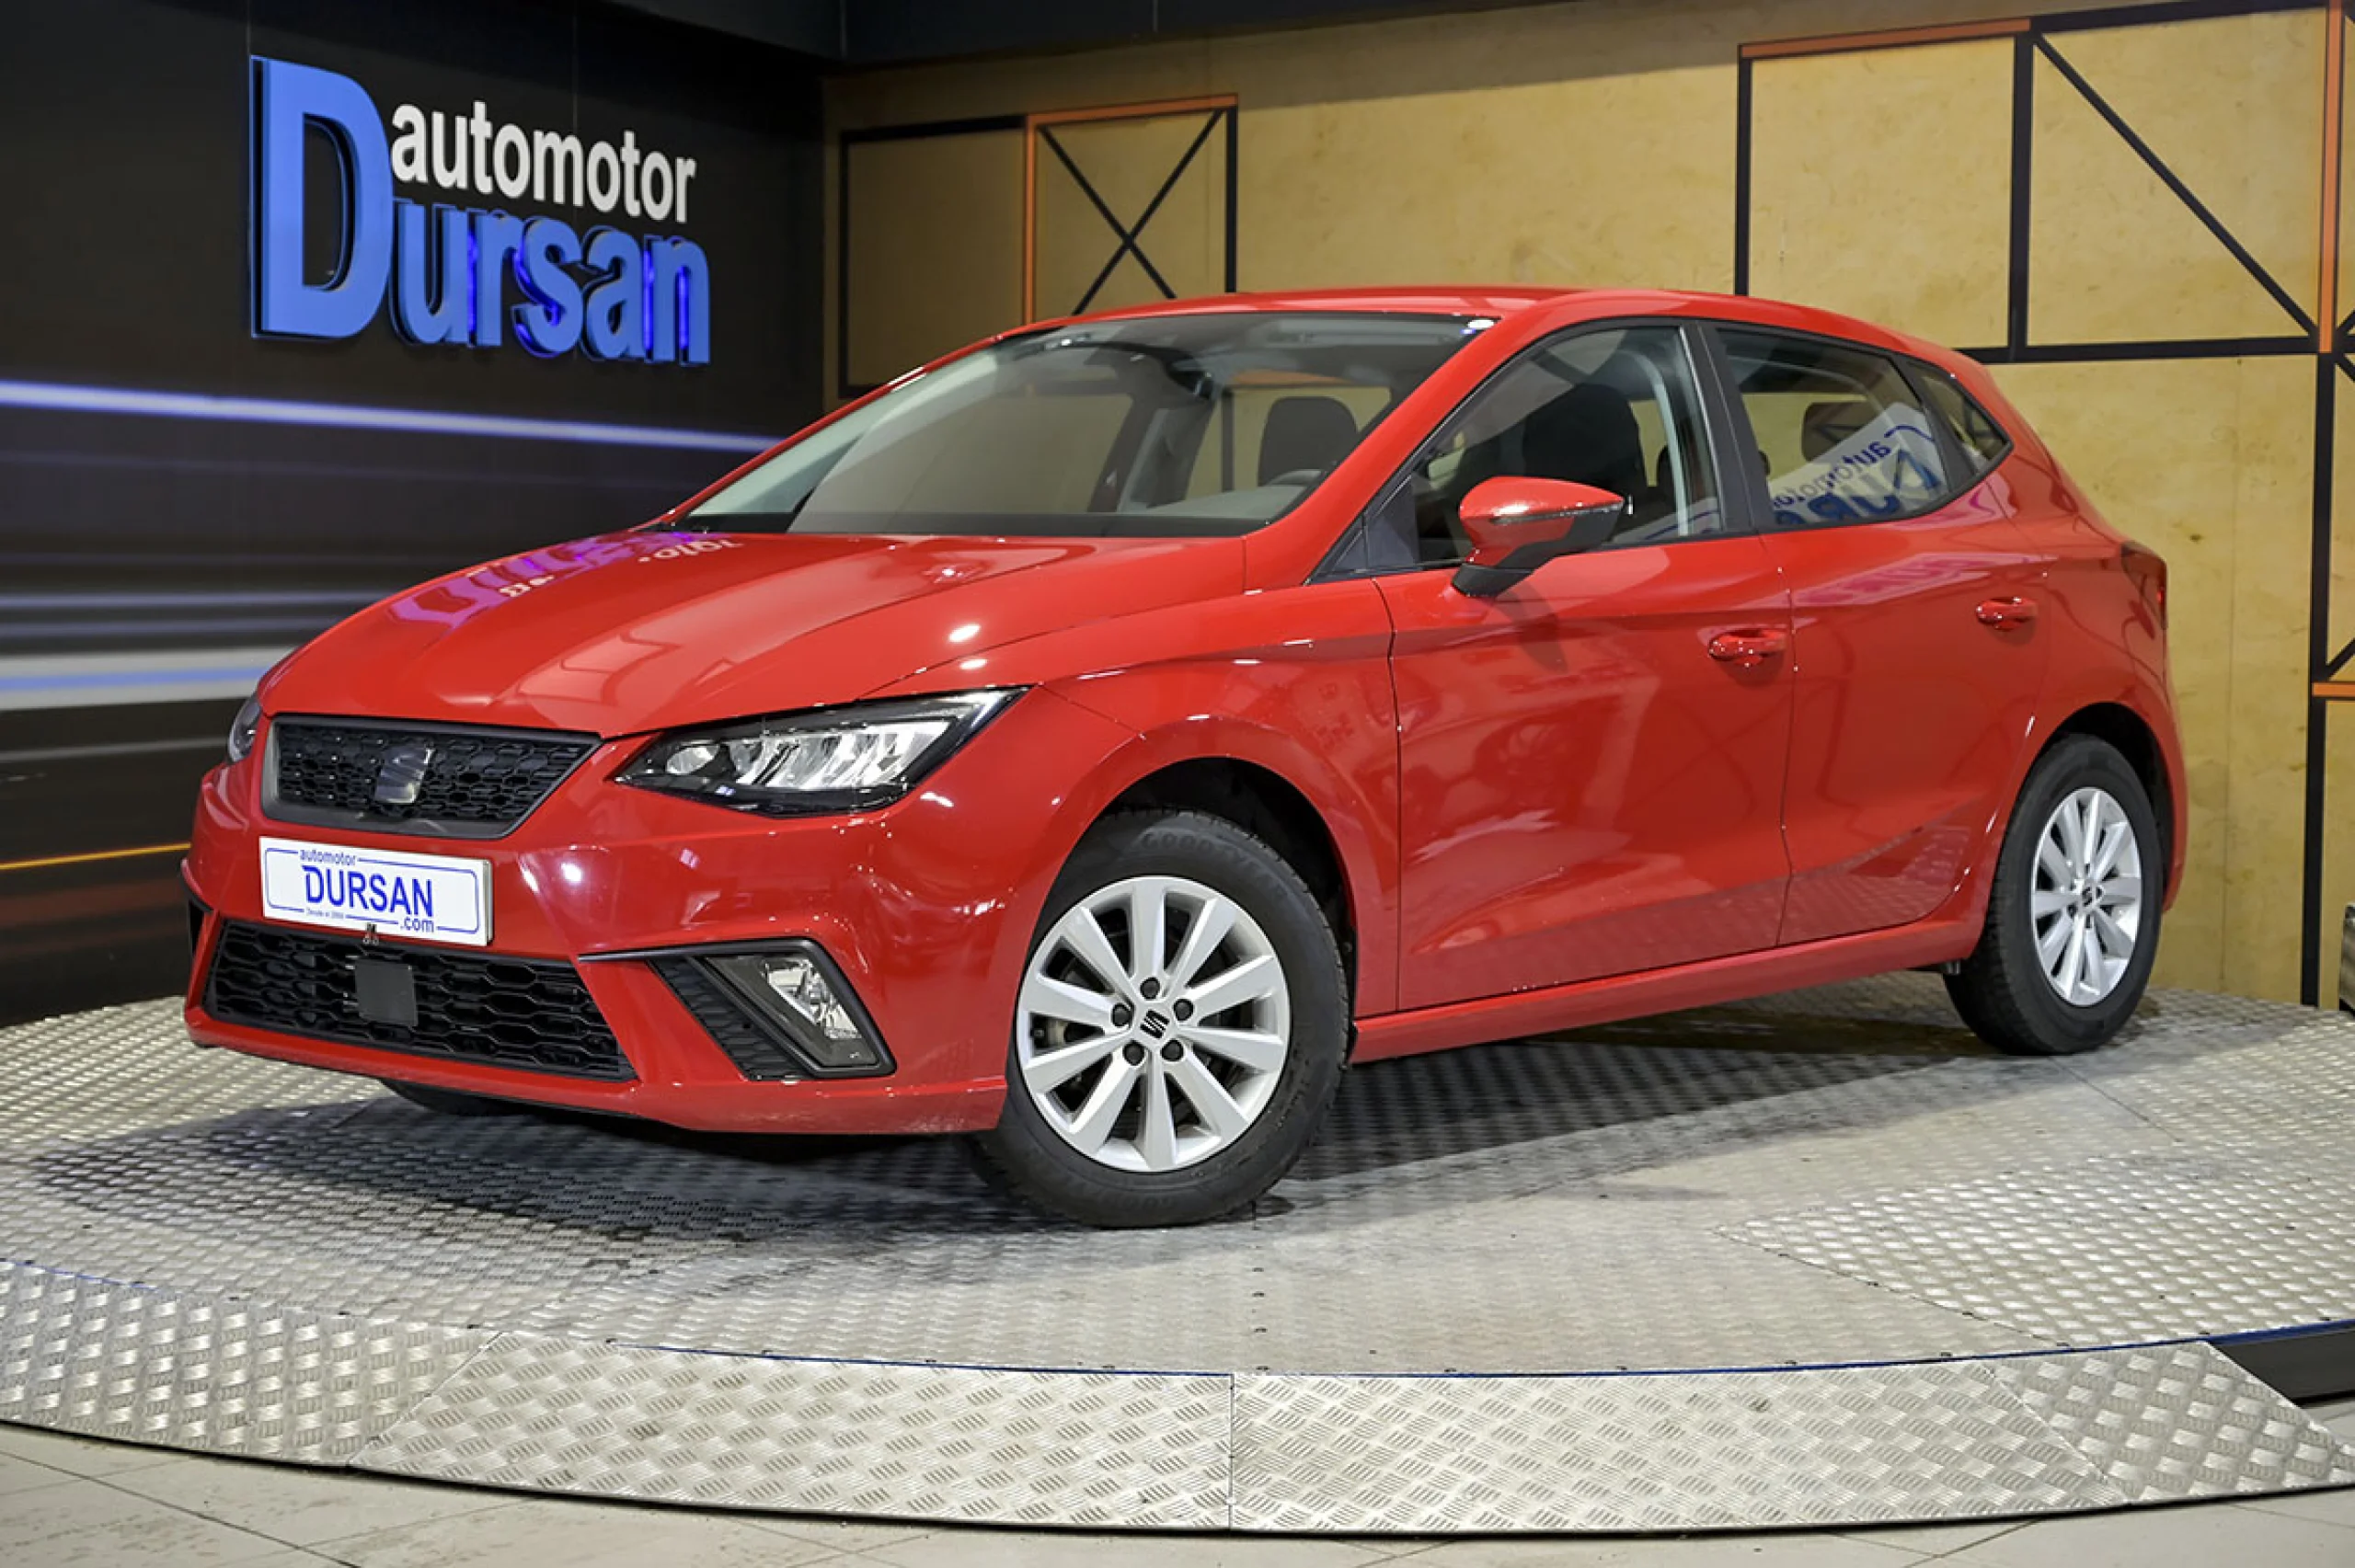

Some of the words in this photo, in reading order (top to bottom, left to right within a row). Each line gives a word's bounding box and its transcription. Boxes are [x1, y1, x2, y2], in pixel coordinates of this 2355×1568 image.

[391, 99, 697, 223] automotor
[251, 55, 710, 366] Dursan
[299, 849, 356, 866] automotor
[303, 865, 433, 917] DURSAN
[400, 916, 435, 933] .com
